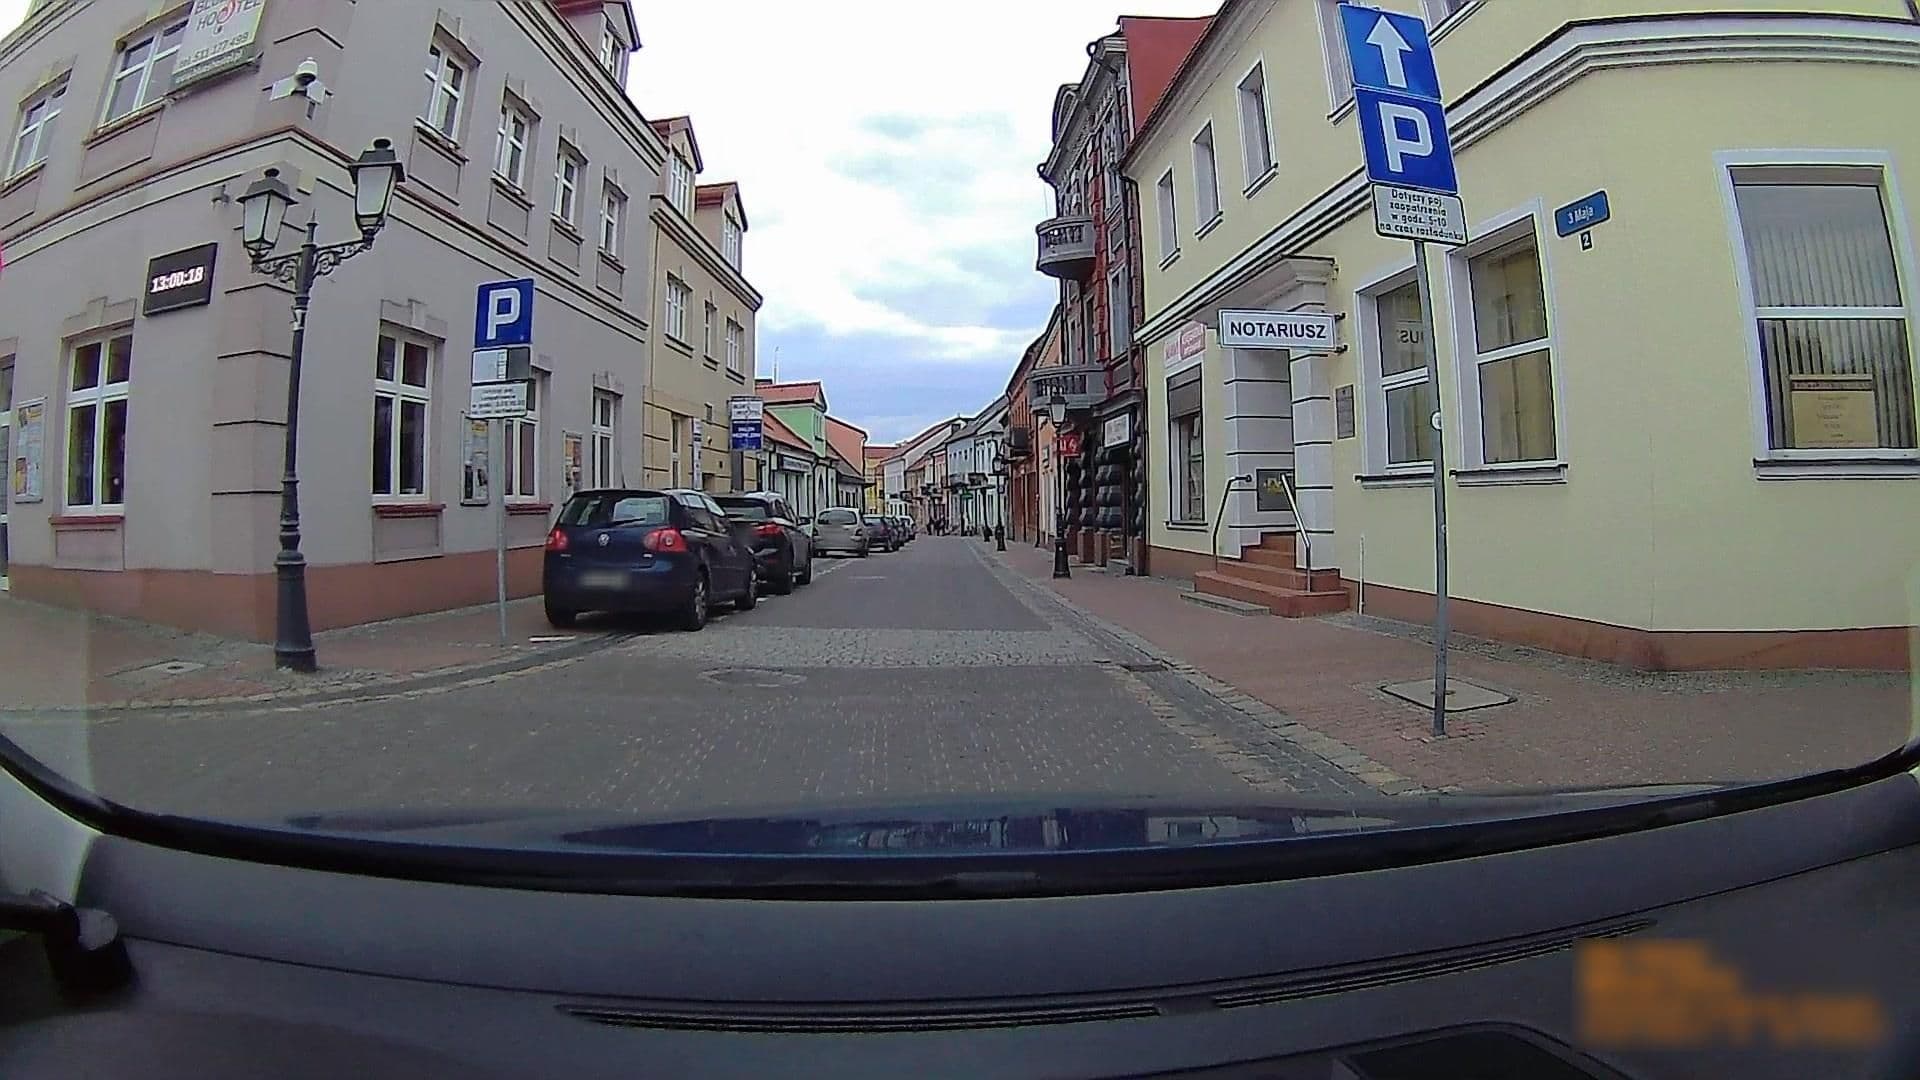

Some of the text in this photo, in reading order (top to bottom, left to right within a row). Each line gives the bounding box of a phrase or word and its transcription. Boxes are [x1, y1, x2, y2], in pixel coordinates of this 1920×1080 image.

[1378, 101, 1433, 173] P
[1391, 188, 1425, 204] Dotyczy
[1567, 211, 1574, 225] 3
[1380, 223, 1391, 231] na
[1582, 233, 1590, 247] 2
[150, 266, 204, 293] 13:00:18
[486, 287, 520, 340] P
[1230, 321, 1327, 339] NOTARIUSZ
